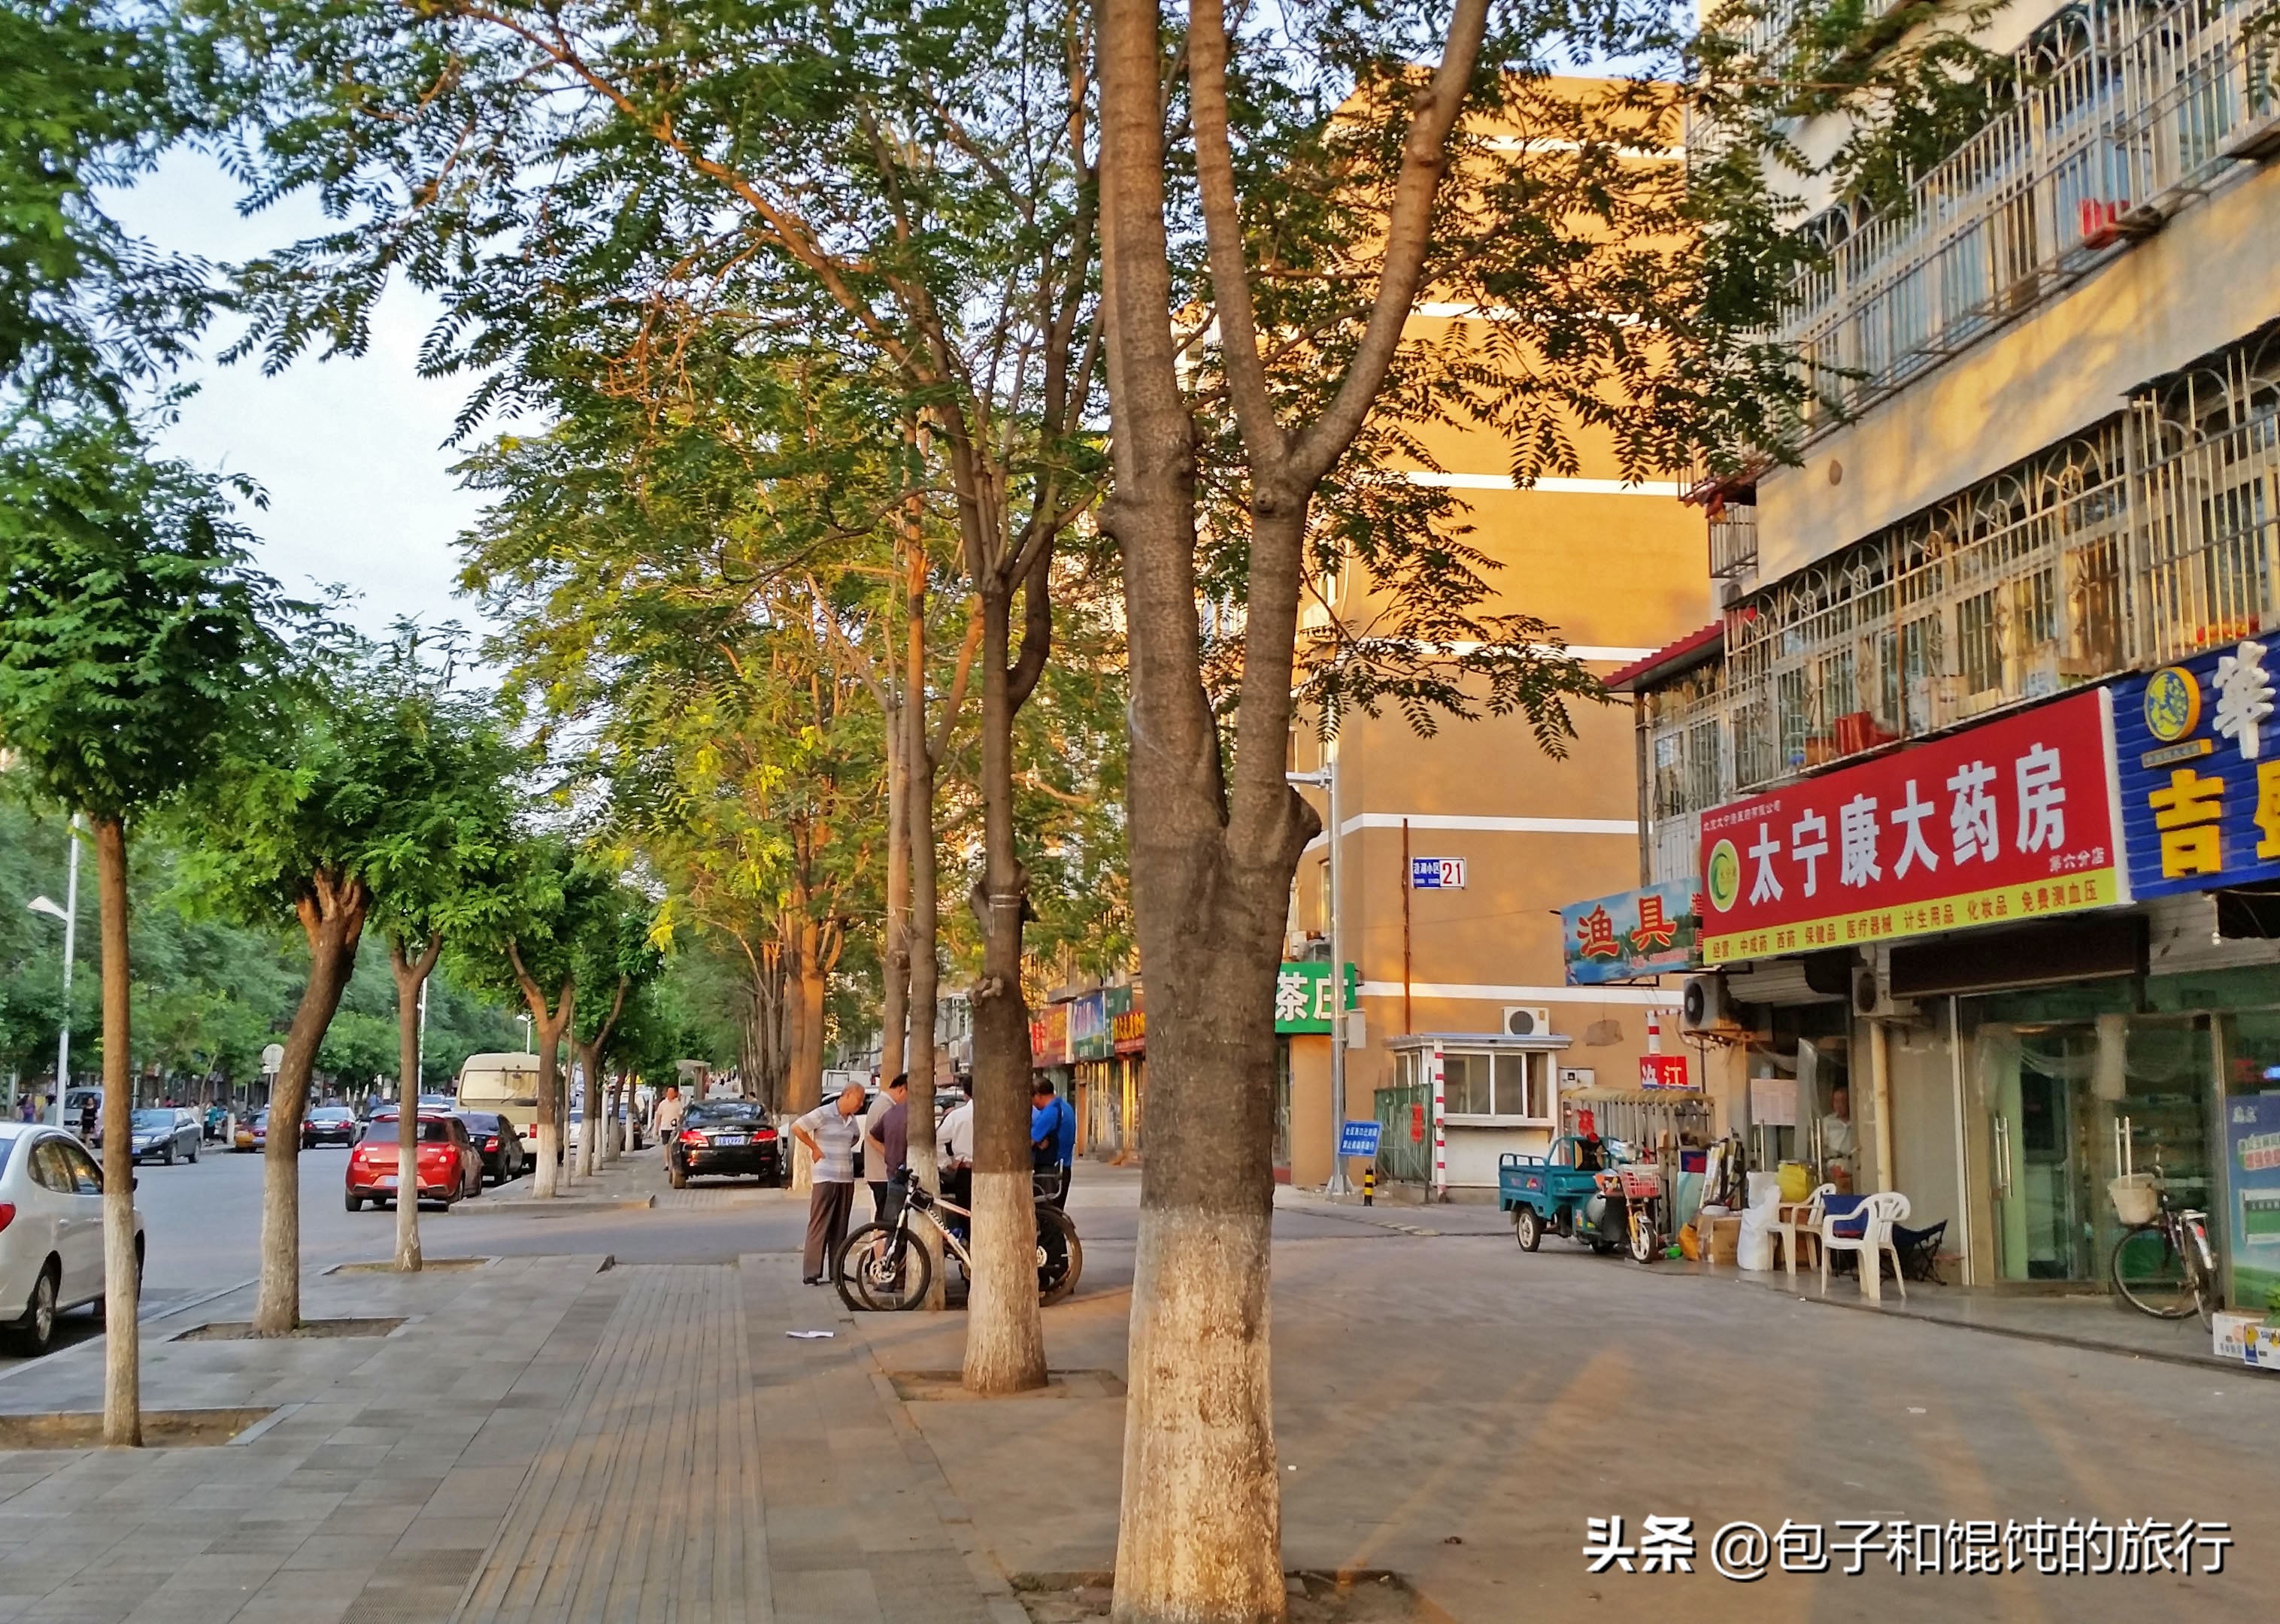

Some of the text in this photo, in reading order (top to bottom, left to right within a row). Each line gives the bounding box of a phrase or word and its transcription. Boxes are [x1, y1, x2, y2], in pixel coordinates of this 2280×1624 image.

[1749, 742, 2066, 906] 太宁康大药房
[1442, 862, 1461, 884] 21
[2049, 847, 2104, 872] 第六分店
[1576, 894, 1678, 959] 渔具
[1777, 930, 1796, 948] 西药
[1806, 923, 1836, 944] 保健品
[1846, 914, 1893, 939] 医疗器械
[1904, 904, 1954, 930] 计生用品
[1967, 895, 2008, 920] 化妆品
[2022, 879, 2097, 912] 免费测血压
[1275, 971, 1349, 1021] 茶庄
